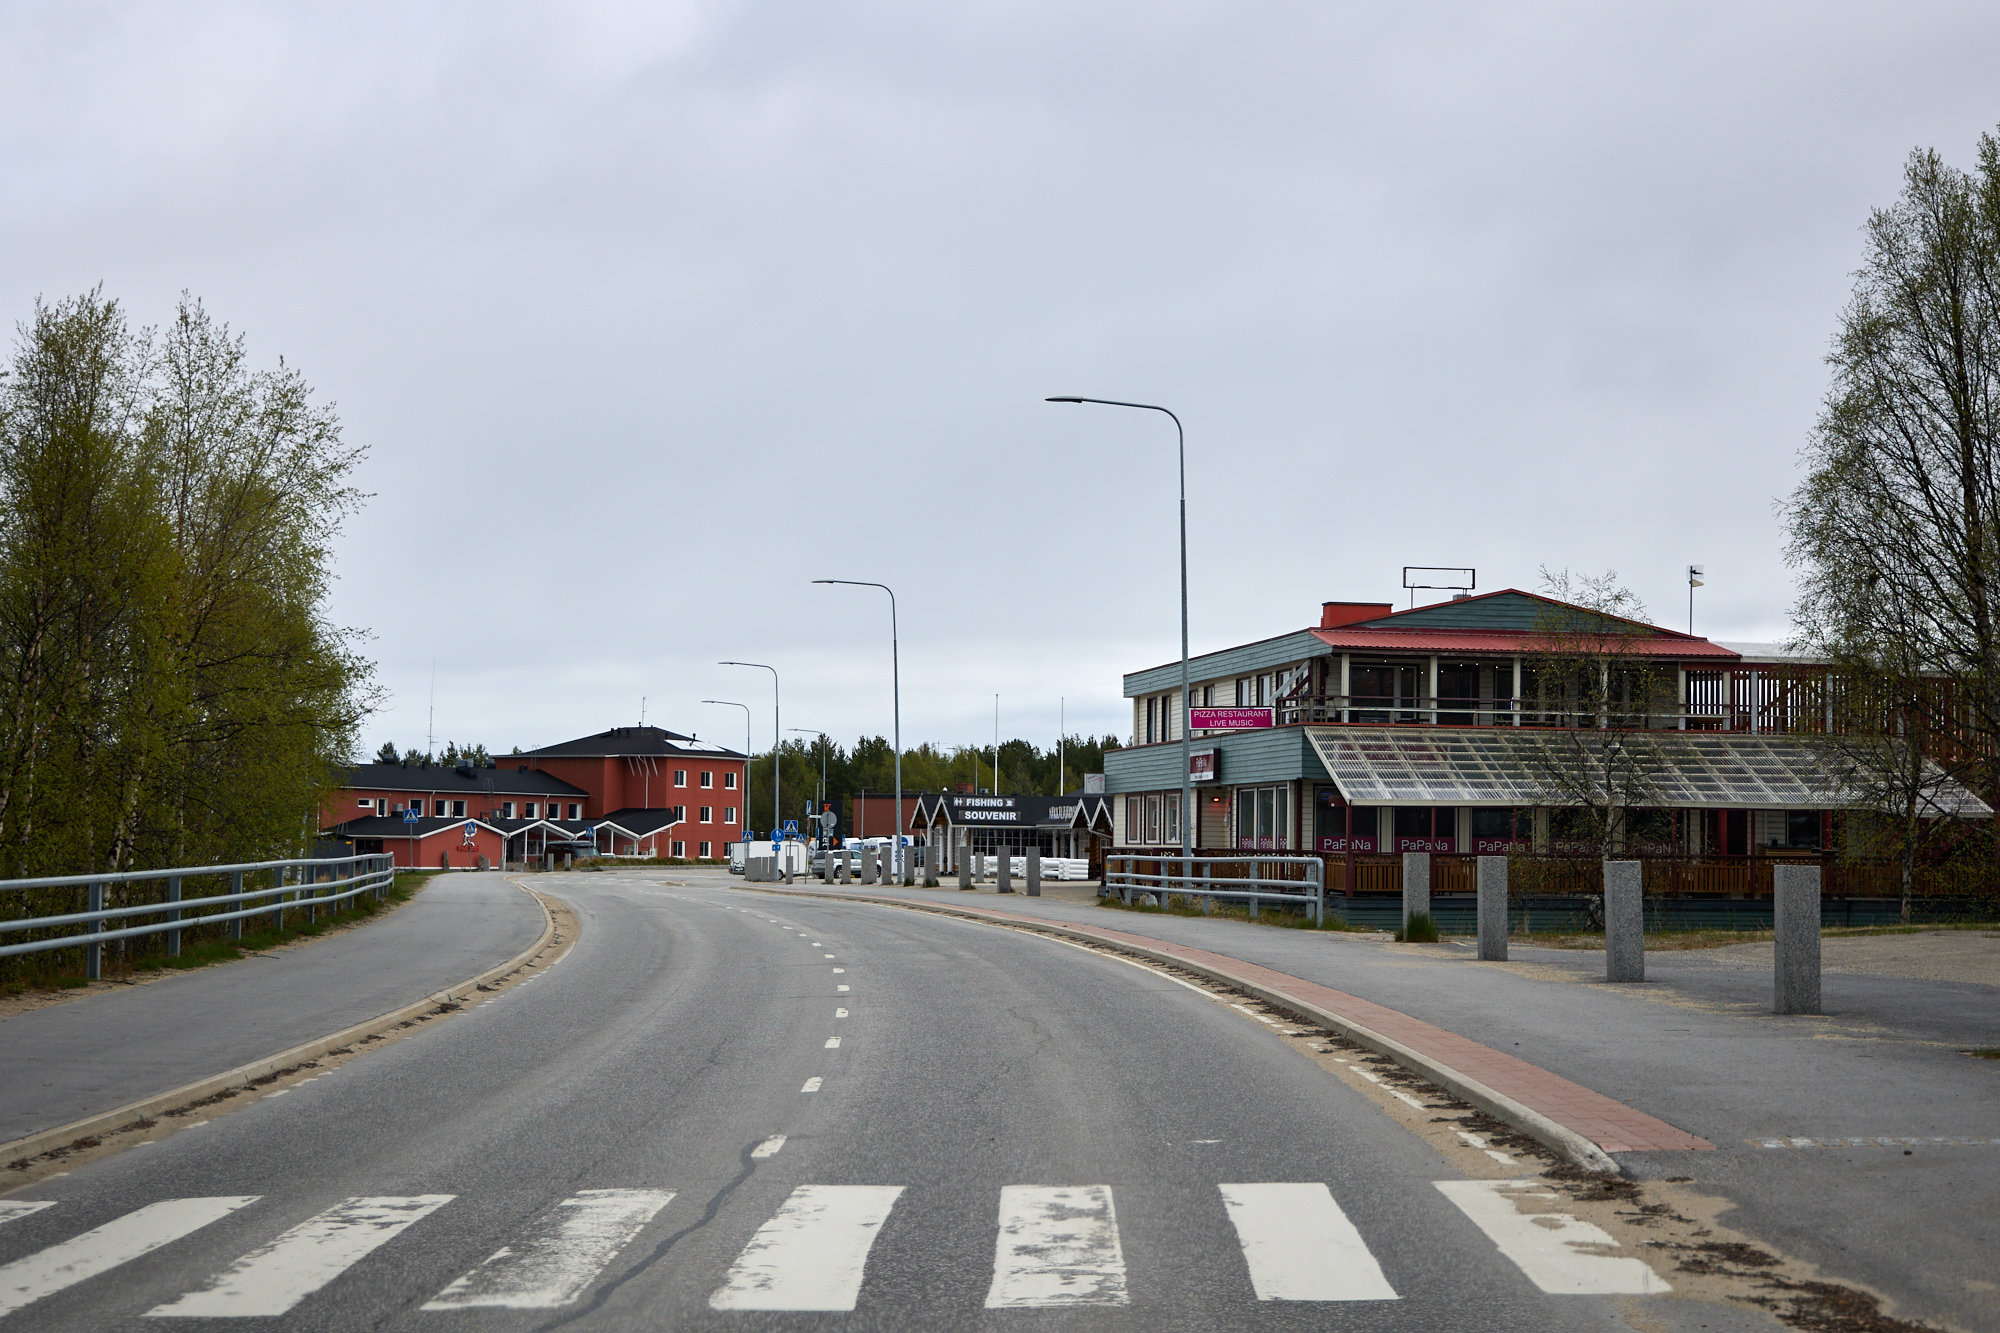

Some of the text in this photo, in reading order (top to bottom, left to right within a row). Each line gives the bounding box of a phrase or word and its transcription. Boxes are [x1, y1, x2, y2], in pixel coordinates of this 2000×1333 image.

[966, 798, 1004, 807] FISHING
[964, 810, 1016, 820] SOUVENIR
[1323, 838, 1371, 850] PaPaNa
[1401, 840, 1448, 850] PaPaNa
